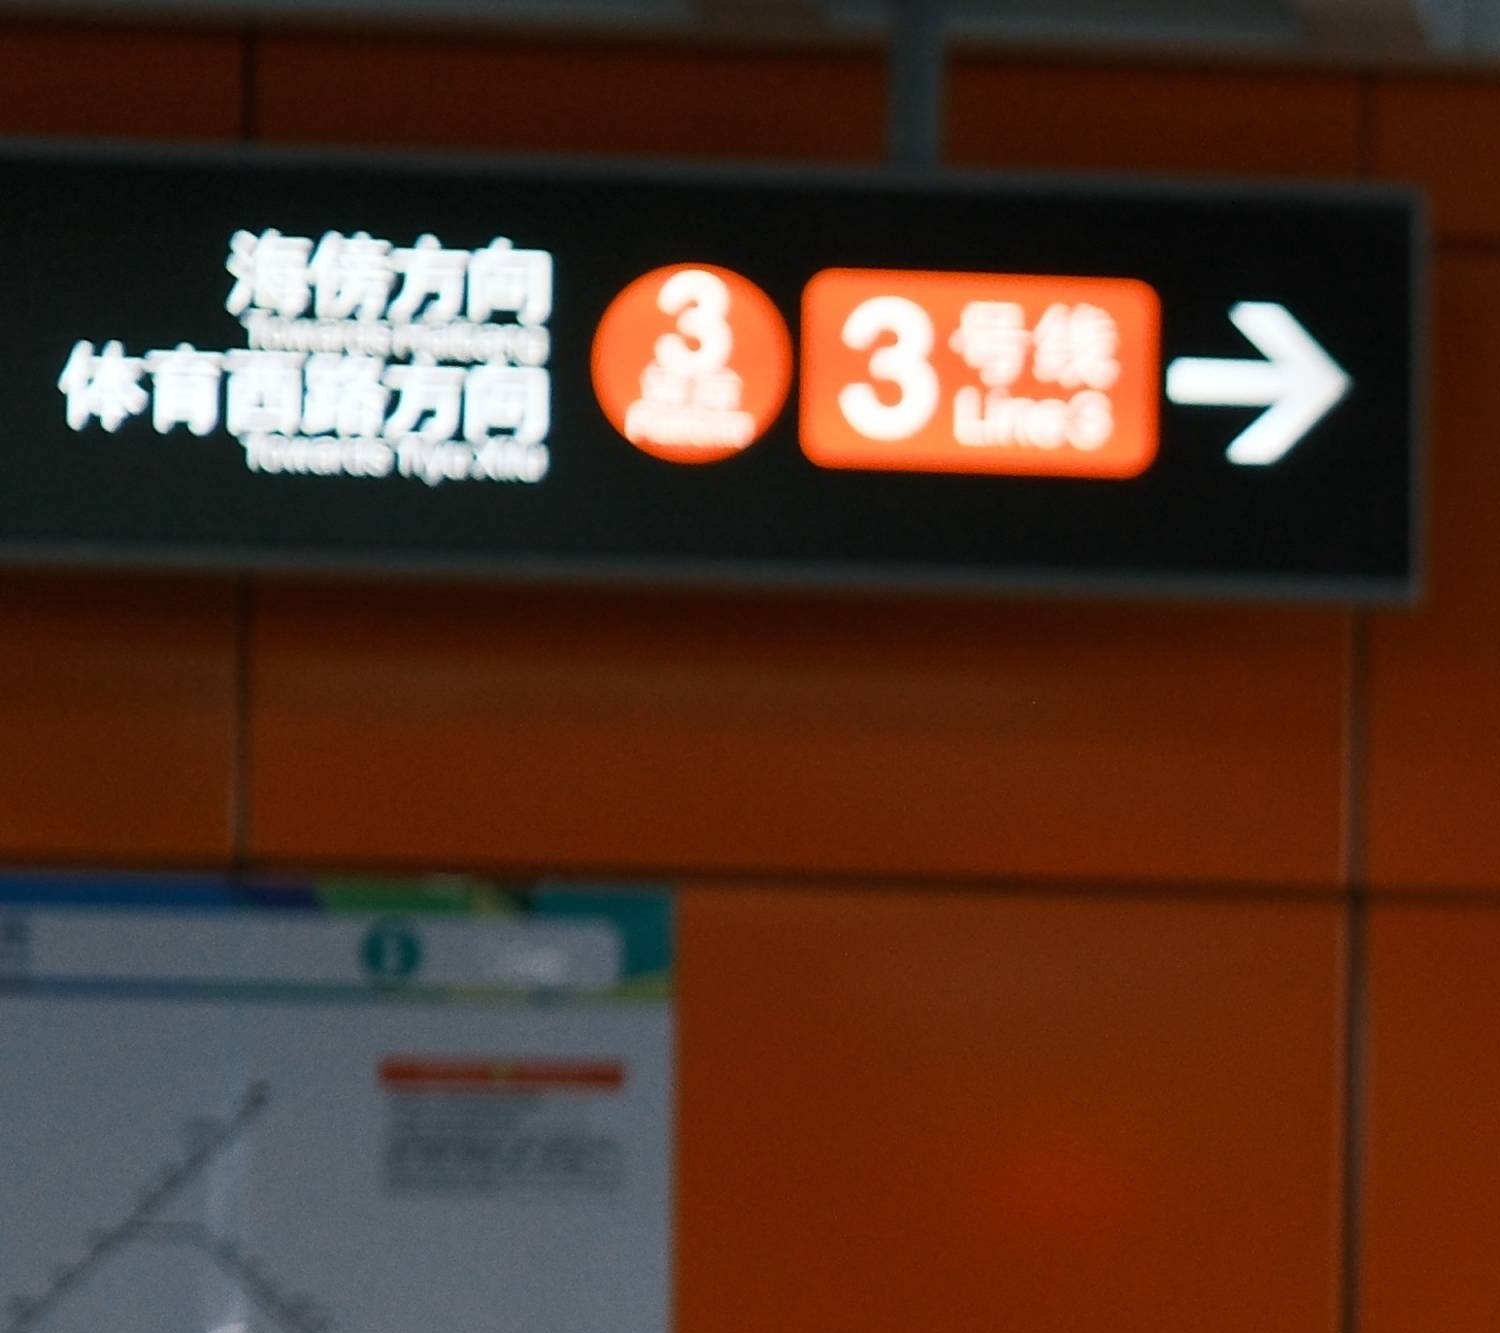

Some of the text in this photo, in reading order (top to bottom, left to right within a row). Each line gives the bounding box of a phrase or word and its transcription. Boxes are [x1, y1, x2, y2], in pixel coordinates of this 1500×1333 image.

[655, 269, 733, 370] 3
[838, 295, 940, 442] 3
[57, 339, 551, 443] 体育西路方向
